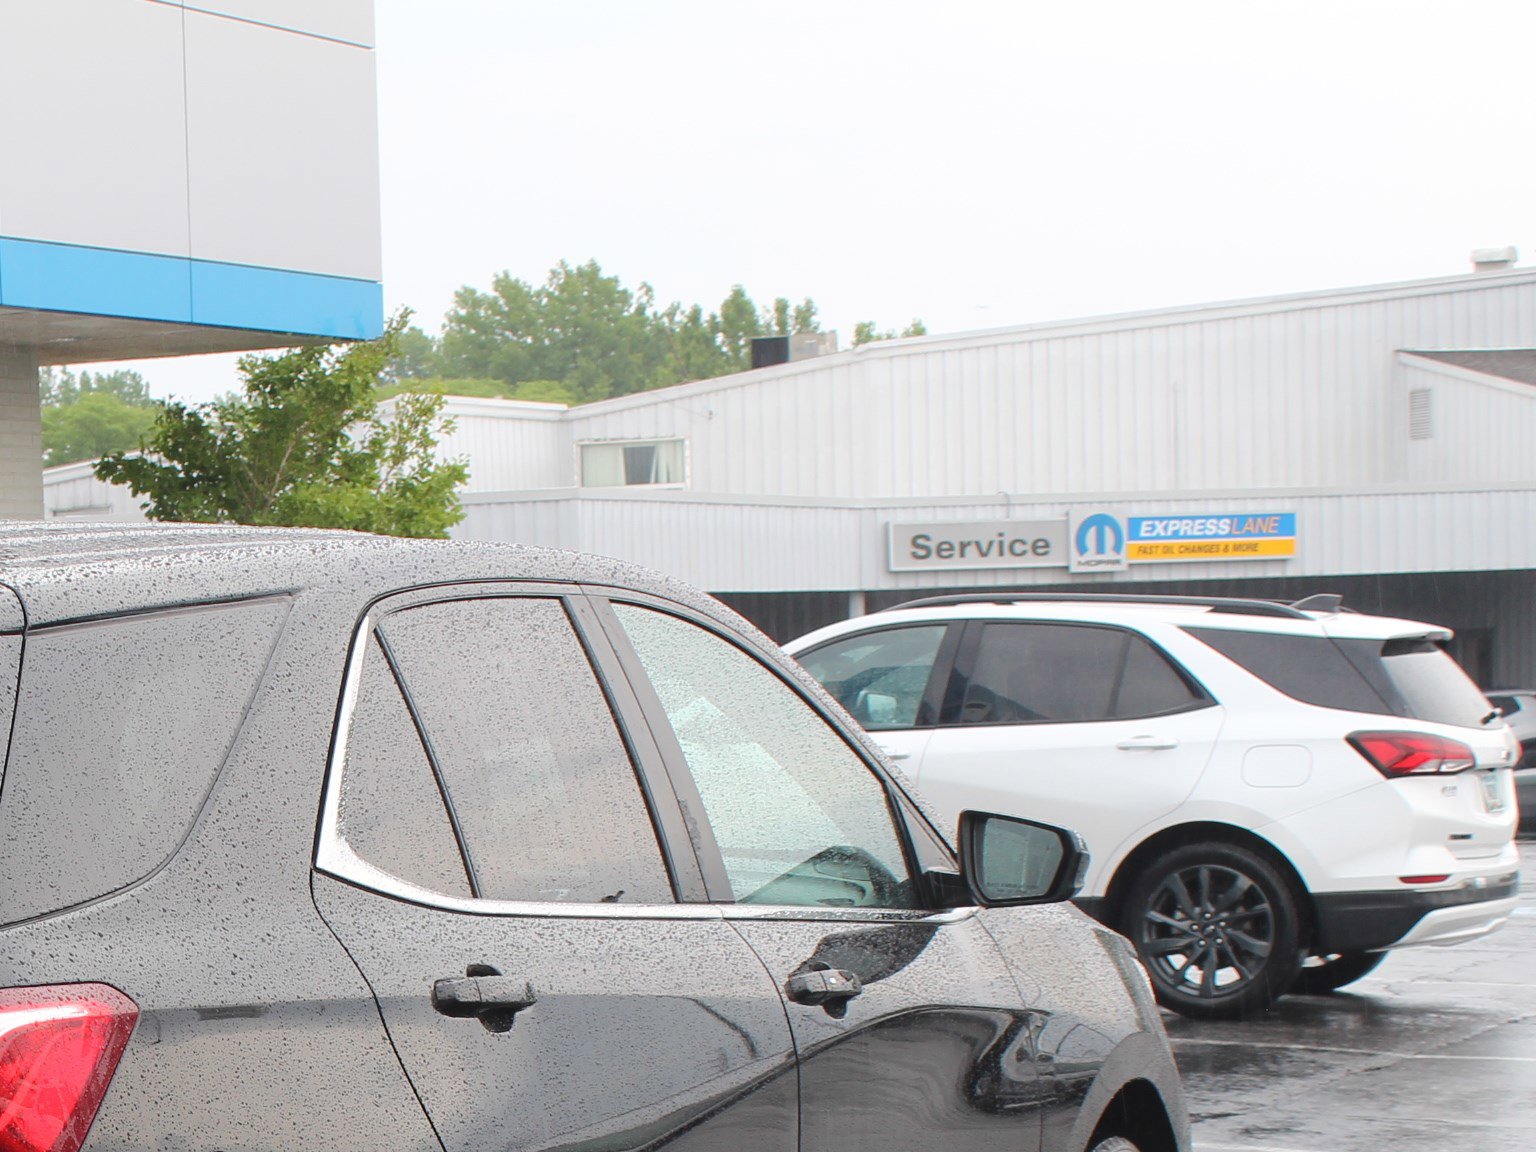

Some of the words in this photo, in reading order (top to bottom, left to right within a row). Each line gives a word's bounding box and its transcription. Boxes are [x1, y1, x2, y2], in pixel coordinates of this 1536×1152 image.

[910, 532, 1051, 560] Service
[1137, 545, 1163, 555] FAST
[1178, 543, 1219, 554] CHANGES
[1232, 543, 1260, 552] MORE
